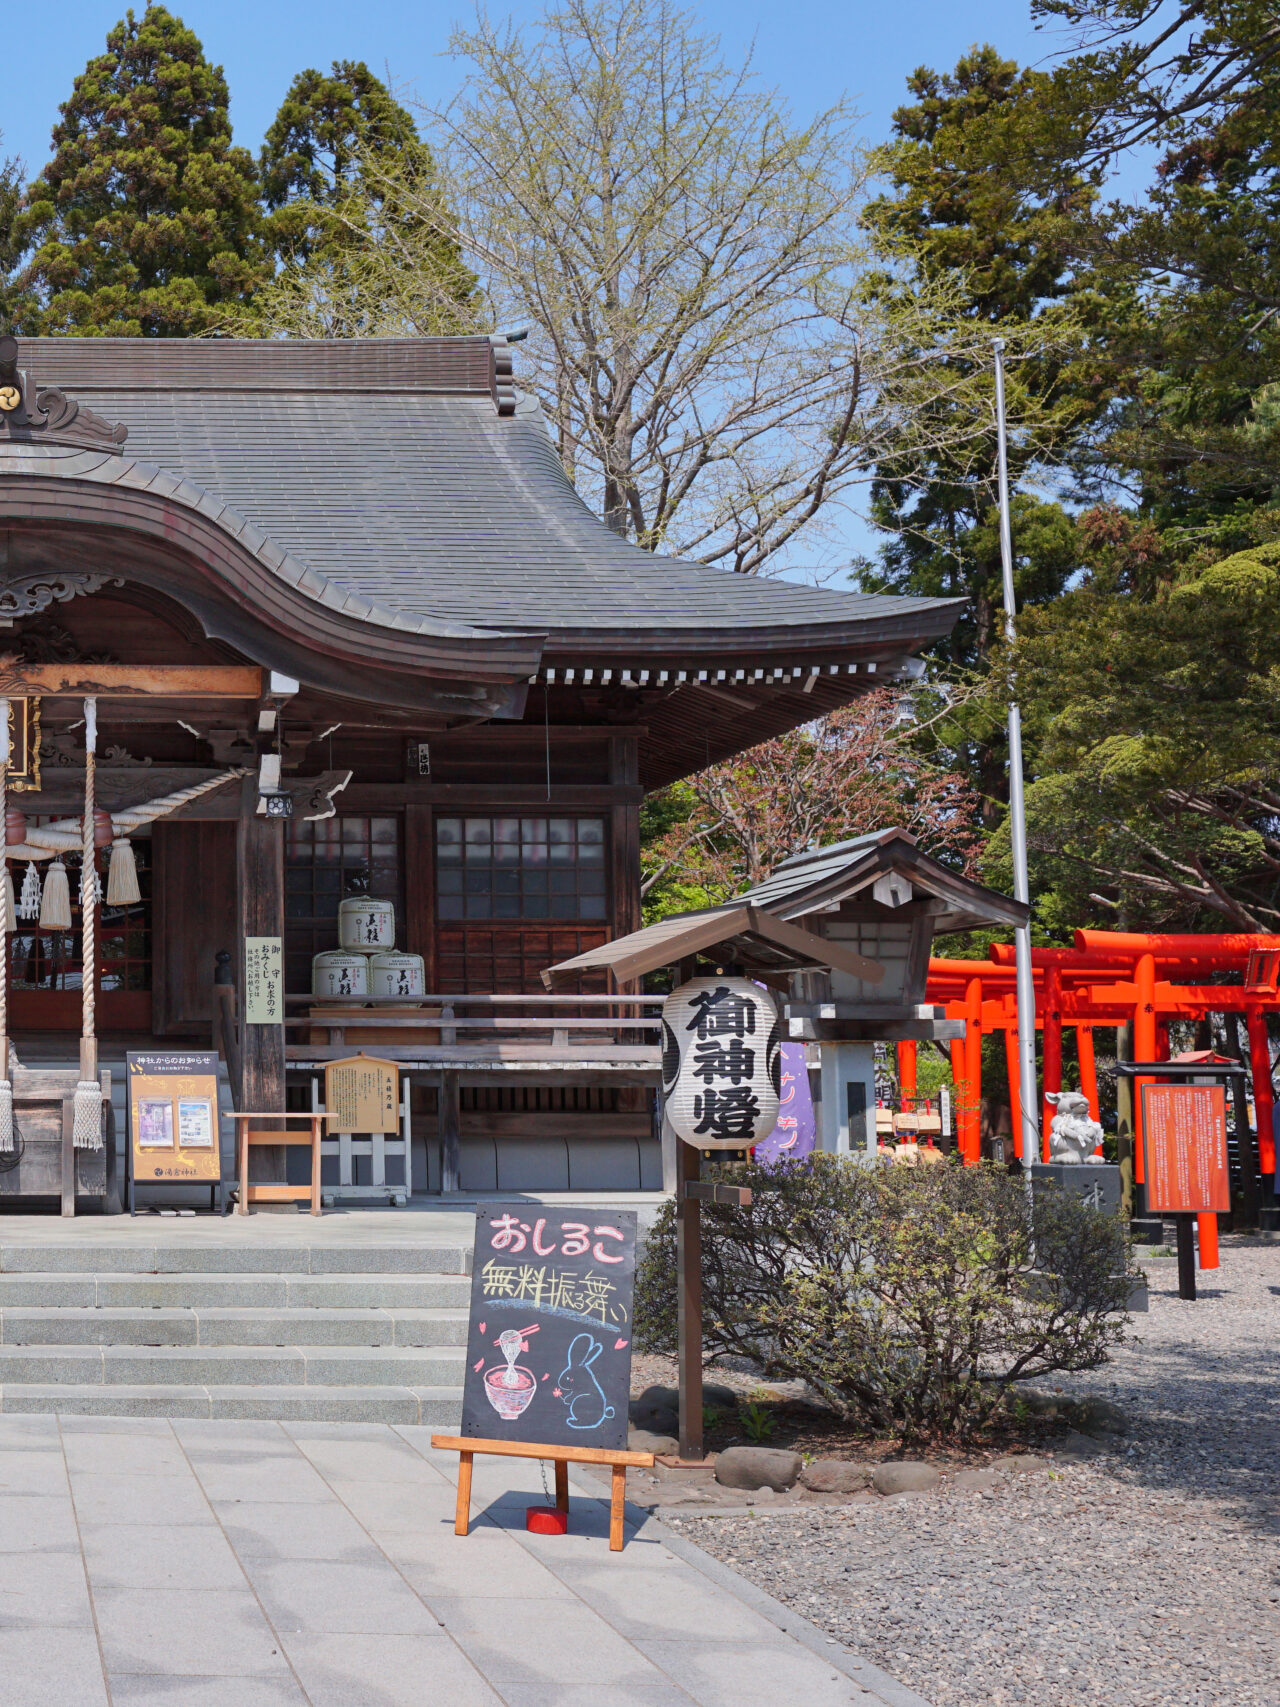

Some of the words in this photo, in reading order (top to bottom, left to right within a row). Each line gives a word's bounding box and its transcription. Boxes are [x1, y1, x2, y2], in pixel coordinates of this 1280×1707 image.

[261, 945, 270, 979] おみくじ
[136, 1056, 211, 1065] 神社からのお知らせ
[686, 986, 760, 1139] 御神燈
[490, 1213, 624, 1263] おしるこ
[481, 1258, 628, 1324] 無料振る舞い
